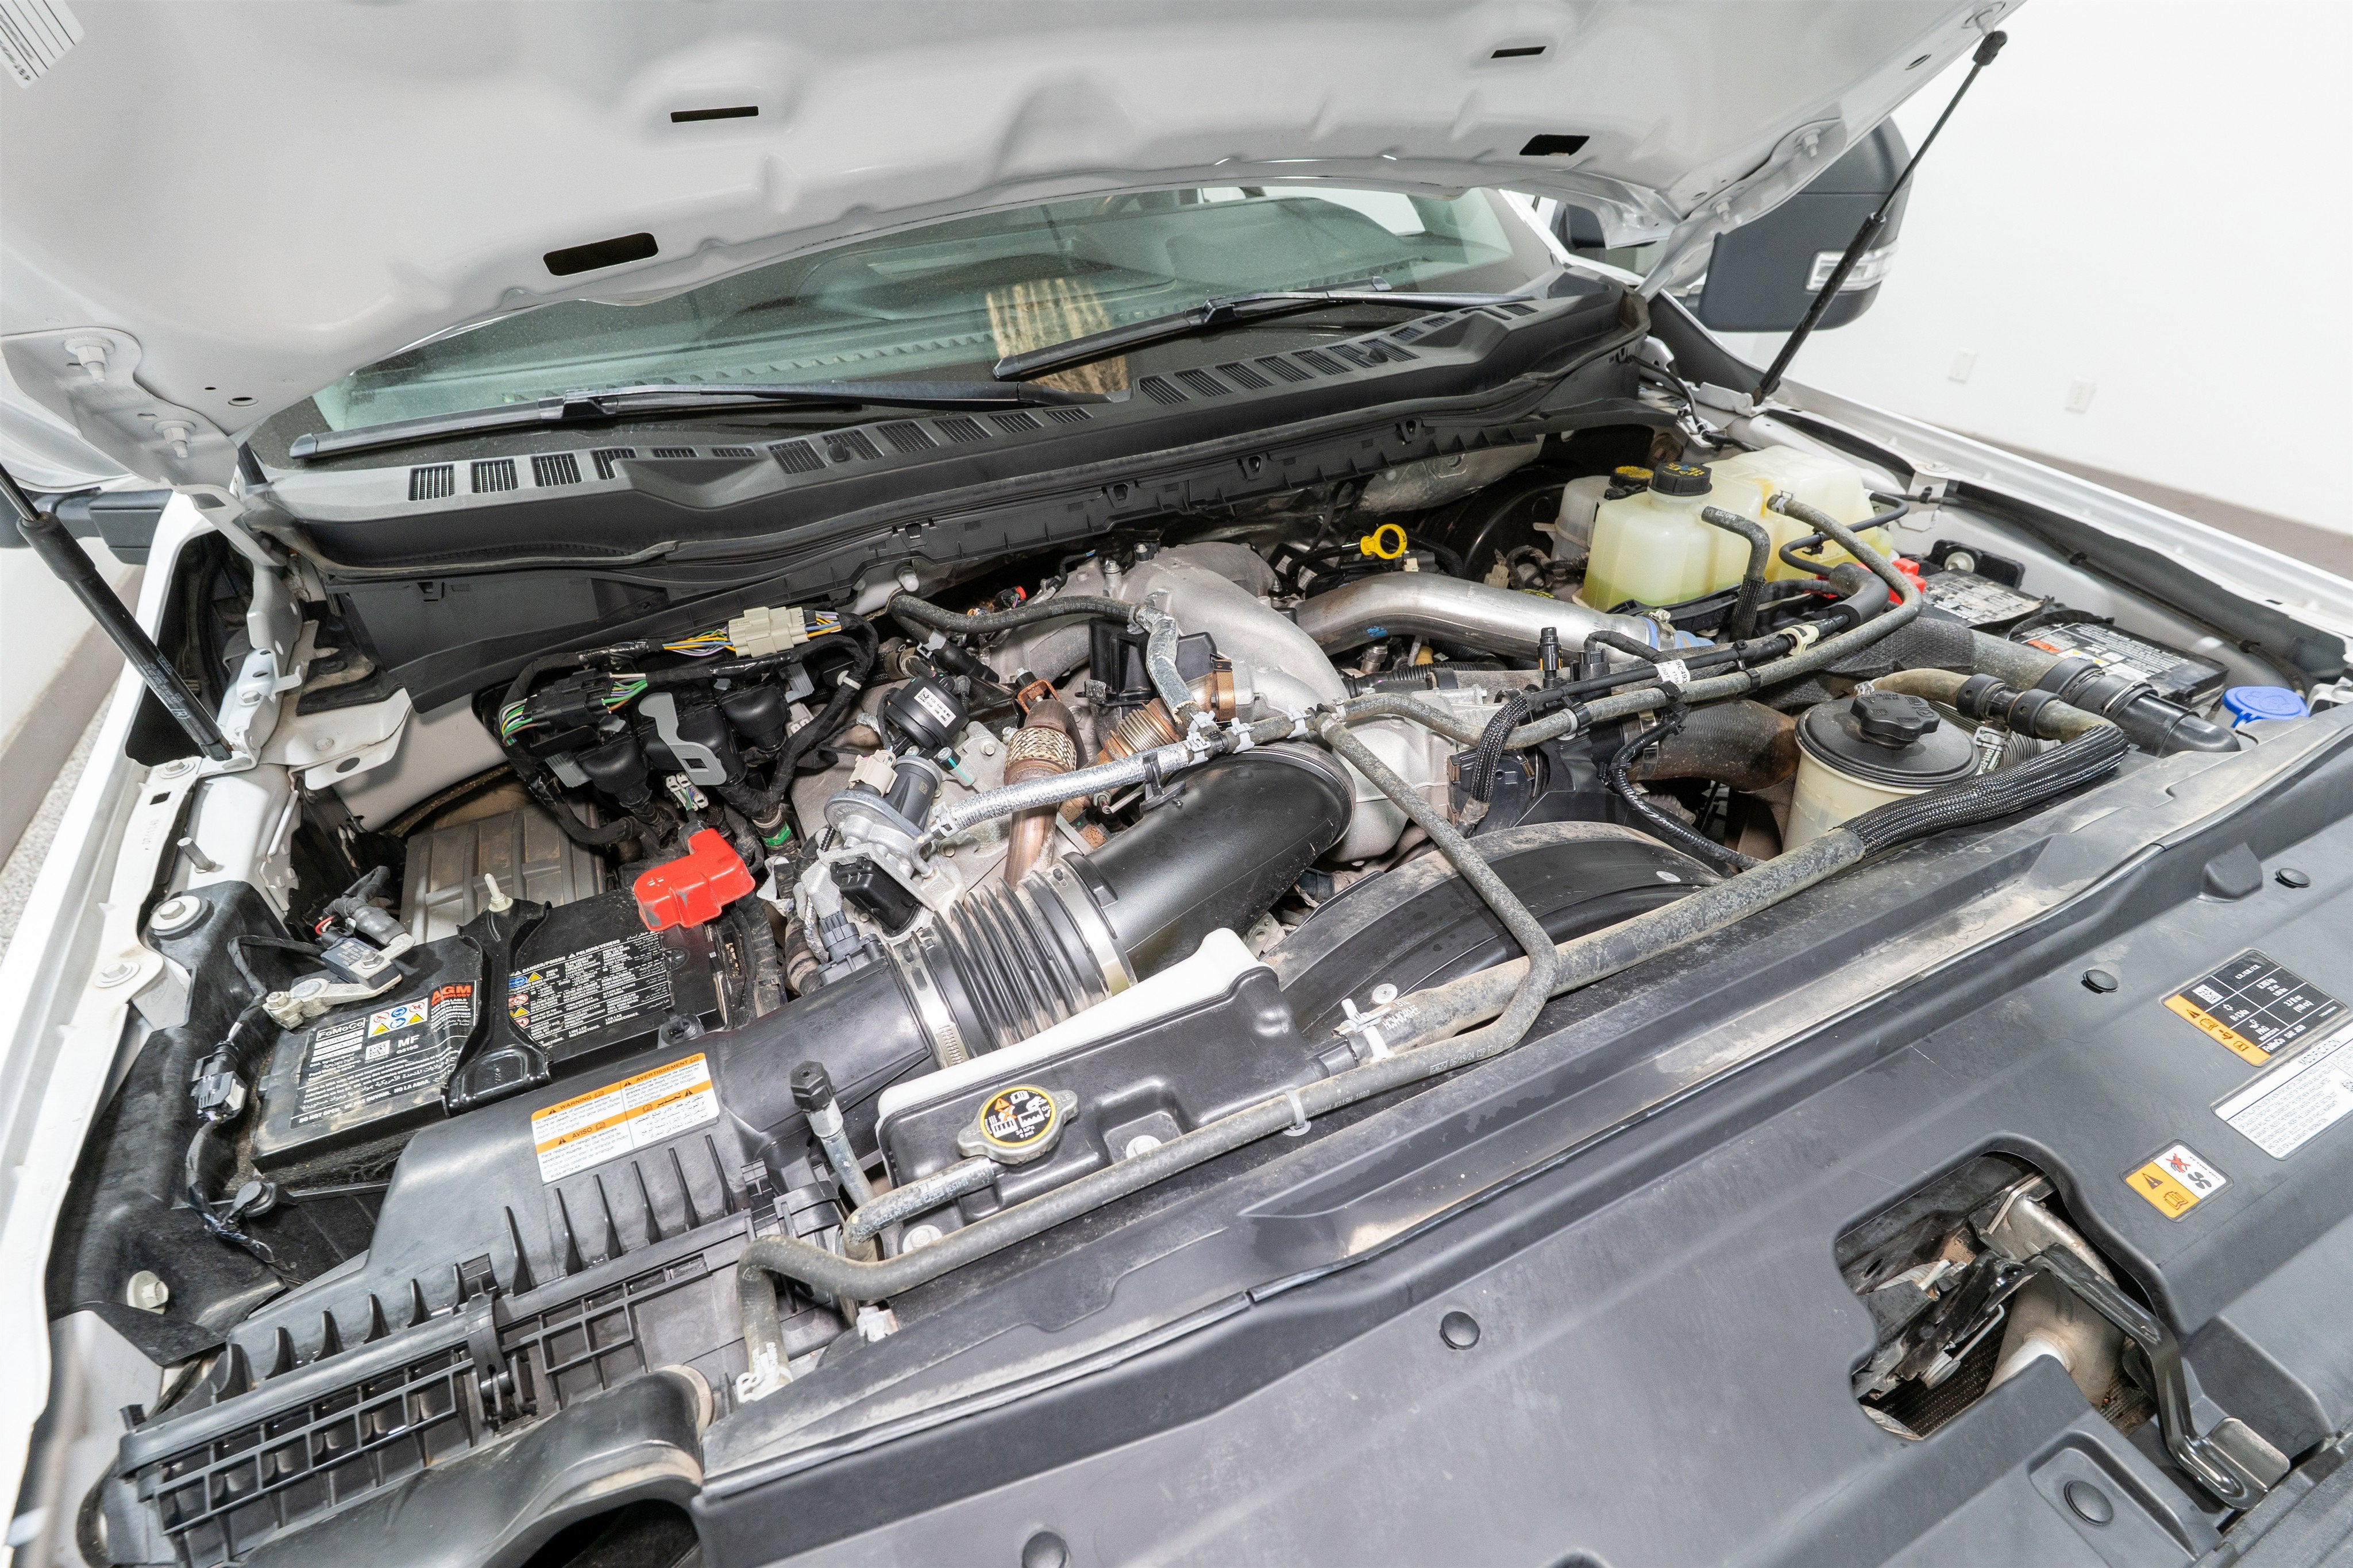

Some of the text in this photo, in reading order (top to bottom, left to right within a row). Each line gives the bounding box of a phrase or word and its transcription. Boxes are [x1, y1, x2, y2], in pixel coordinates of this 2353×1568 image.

[576, 939, 620, 956] PELIGRO/VENENO
[522, 956, 565, 973] DANGER/POISON
[431, 985, 472, 1002] AGM
[605, 1011, 639, 1025] INSTRUCCIONES.
[2228, 1008, 2250, 1021] R-134a
[318, 1020, 363, 1038] FoMoCo
[569, 1024, 600, 1038] INSTRUCTIONS.
[2254, 1025, 2270, 1035] PAG
[397, 1034, 419, 1048] MF
[2261, 1037, 2286, 1052] FoMoCo
[2282, 1029, 2297, 1039] SAE
[2298, 1037, 2340, 1066] MODIFICATION
[636, 1060, 688, 1082] AVERTISSEMENT
[299, 1115, 308, 1123] DO
[308, 1111, 322, 1120] NOT
[322, 1105, 342, 1116] OPEN.
[353, 1098, 365, 1107] PAS
[365, 1090, 391, 1103] OUVRIR.
[393, 1087, 403, 1095] NO
[403, 1084, 412, 1092] LA
[412, 1078, 430, 1089] ABRA.
[560, 1095, 591, 1110] WARNING
[657, 1092, 681, 1107] تحذير
[572, 1126, 592, 1138] AVISO
